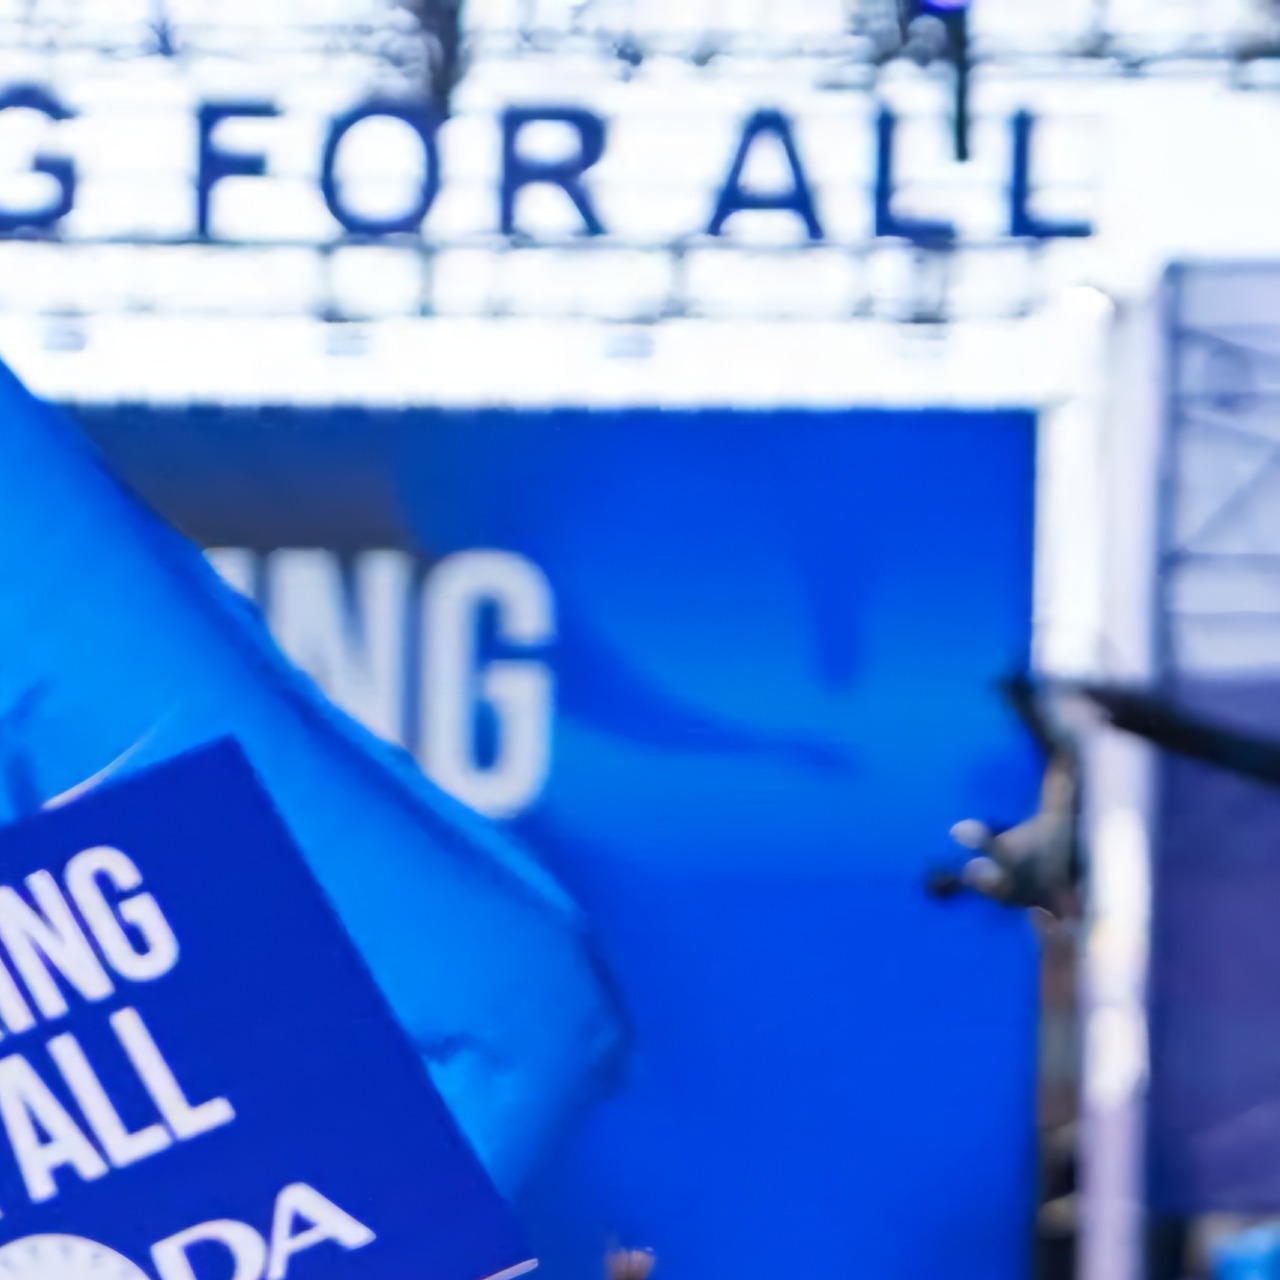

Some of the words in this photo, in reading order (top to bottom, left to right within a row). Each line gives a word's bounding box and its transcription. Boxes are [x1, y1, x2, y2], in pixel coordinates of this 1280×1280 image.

[194, 100, 610, 240] FOR
[705, 105, 1094, 242] ALL
[202, 546, 556, 820] NG
